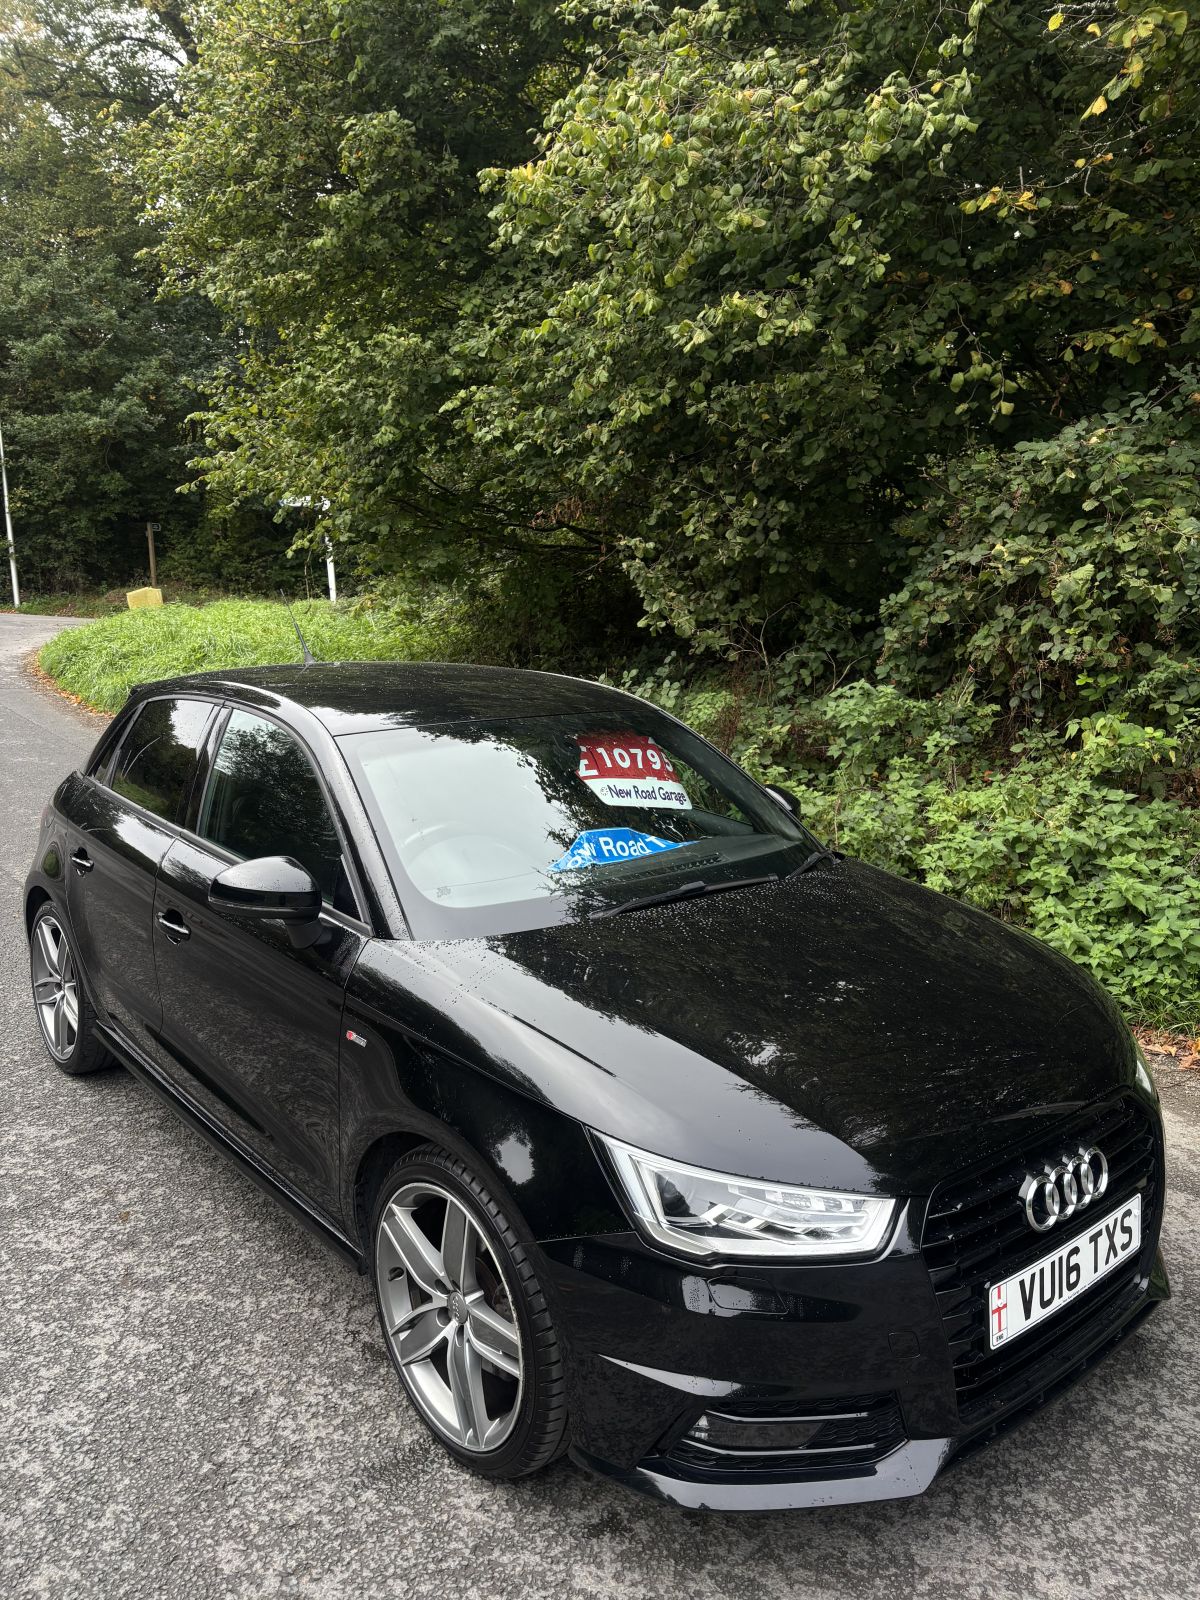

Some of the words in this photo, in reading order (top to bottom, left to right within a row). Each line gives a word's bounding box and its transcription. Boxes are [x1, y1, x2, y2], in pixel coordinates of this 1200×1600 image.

[607, 784, 632, 799] New
[633, 785, 657, 800] Road
[658, 786, 687, 806] Garage
[599, 837, 652, 857] Road
[1019, 1245, 1081, 1321] VU16
[1088, 1208, 1133, 1275] TXS
